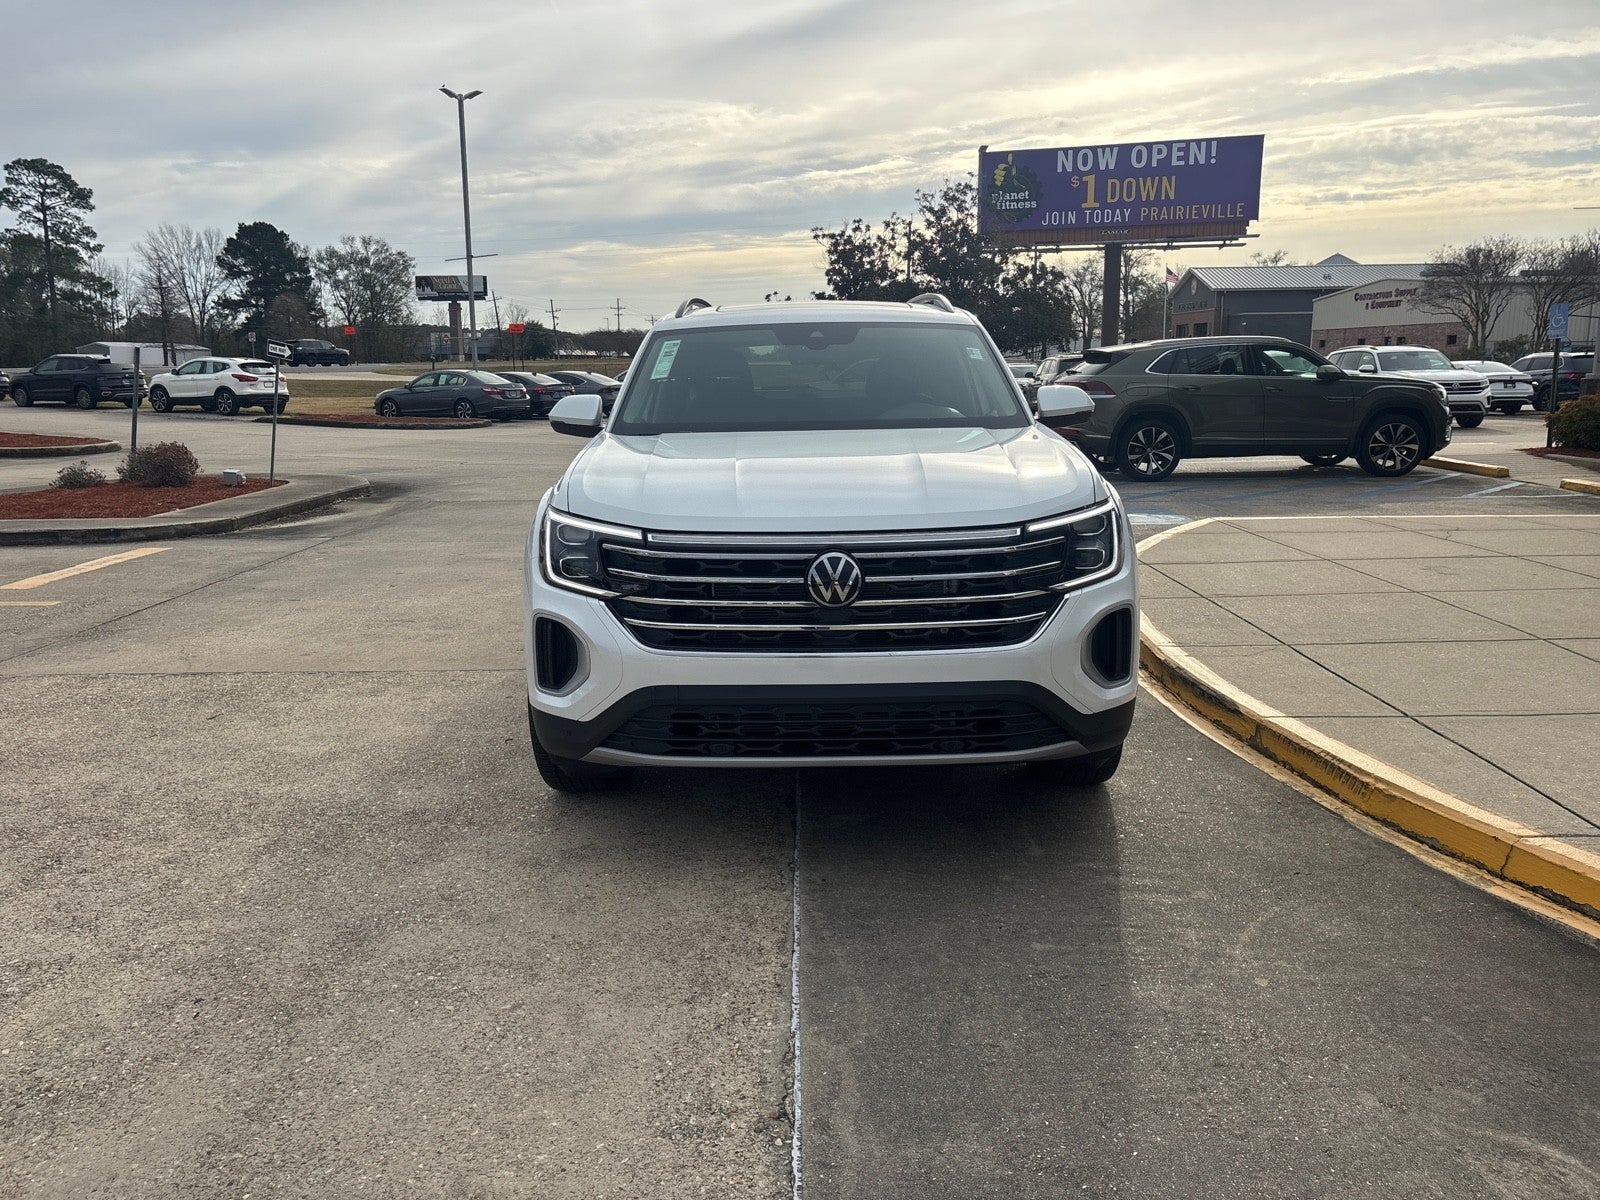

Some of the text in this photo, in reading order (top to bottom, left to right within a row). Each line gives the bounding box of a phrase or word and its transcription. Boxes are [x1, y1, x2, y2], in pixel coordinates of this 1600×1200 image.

[1057, 141, 1217, 172] NOW OPEN!
[1106, 175, 1176, 203] DOWN
[1041, 203, 1245, 226] JOIN TODAY PRAIRIEVILLE
